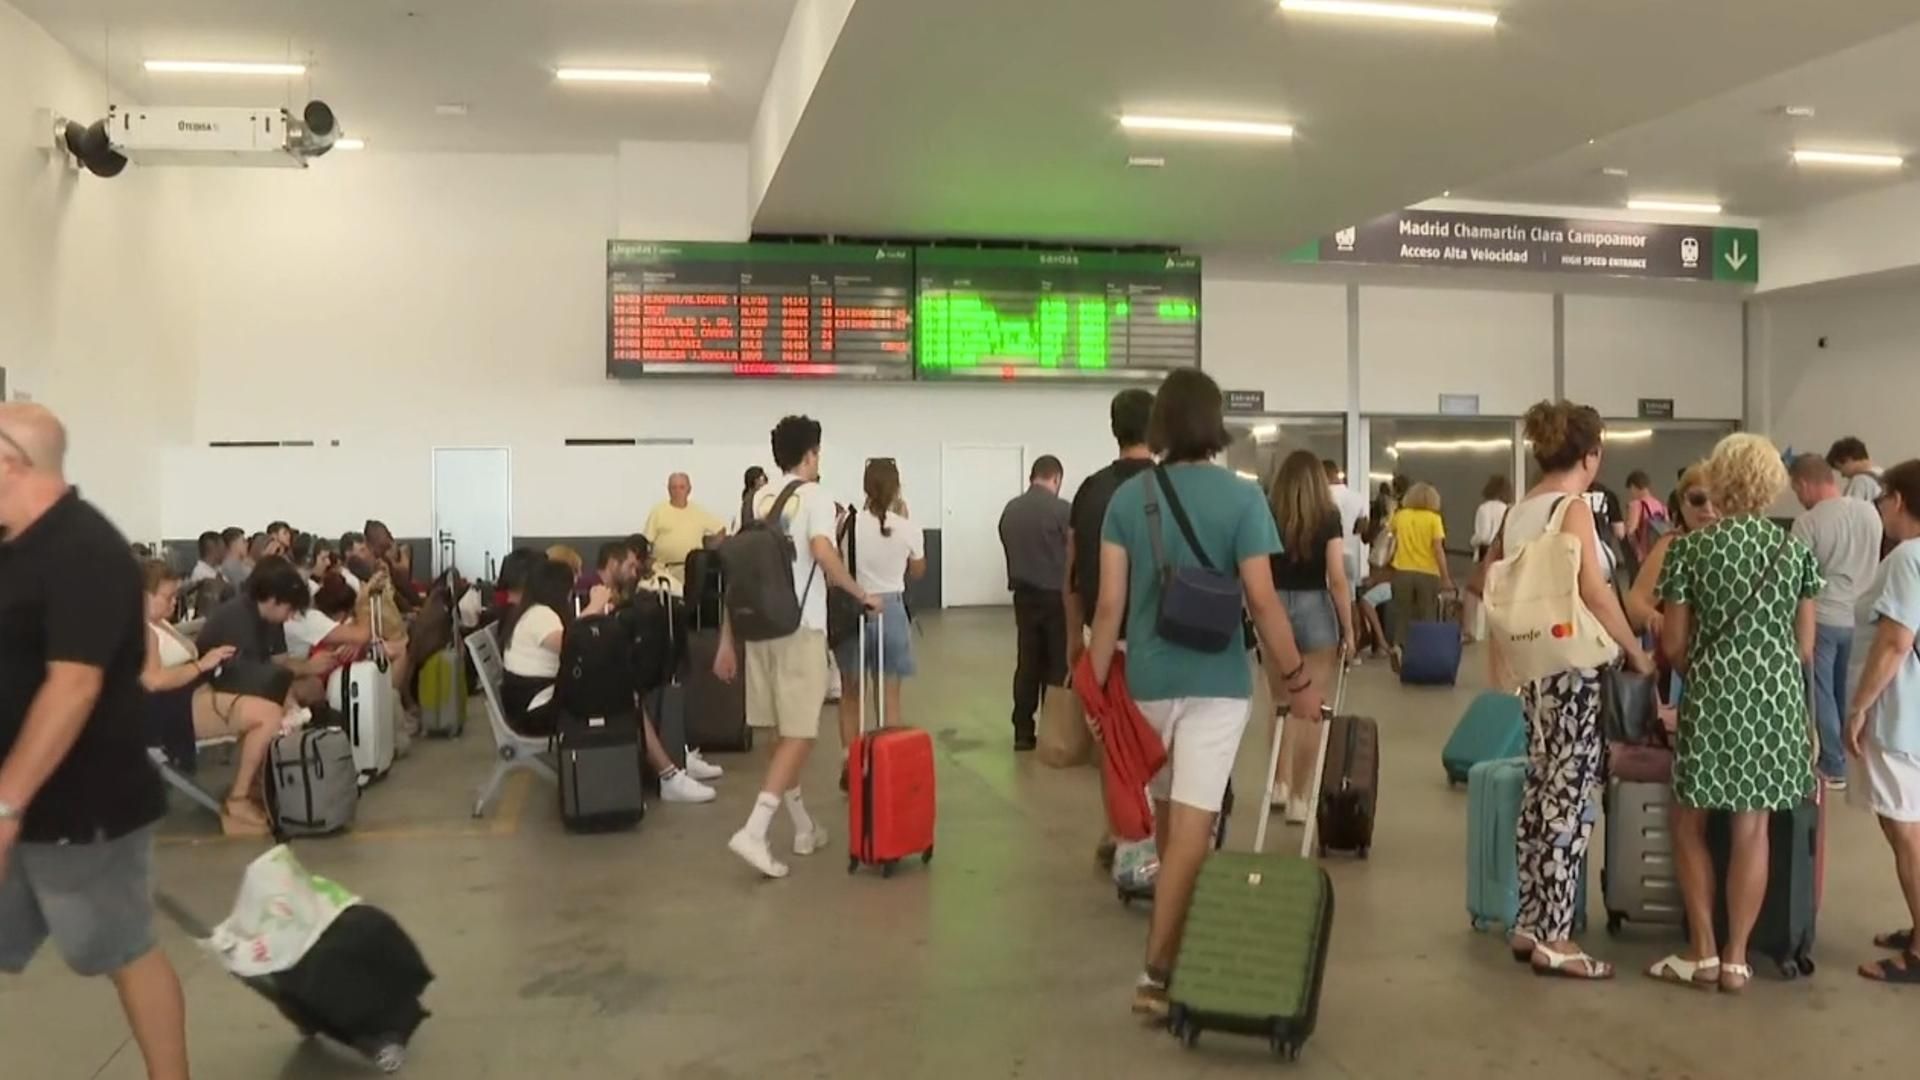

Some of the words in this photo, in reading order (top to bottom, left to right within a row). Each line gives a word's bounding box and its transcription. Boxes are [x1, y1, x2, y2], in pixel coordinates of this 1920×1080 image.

[1400, 220, 1449, 237] Madrid
[1454, 222, 1526, 241] Chamartín
[1531, 227, 1563, 243] Clara
[1568, 229, 1646, 248] Campoamor
[1400, 245, 1440, 259] Acceso
[1444, 246, 1467, 260] Alta
[1470, 247, 1528, 263] Velocidad
[1561, 255, 1581, 265] HIGH
[1583, 257, 1606, 266] SPEED
[1608, 258, 1647, 269] ENTRANCE
